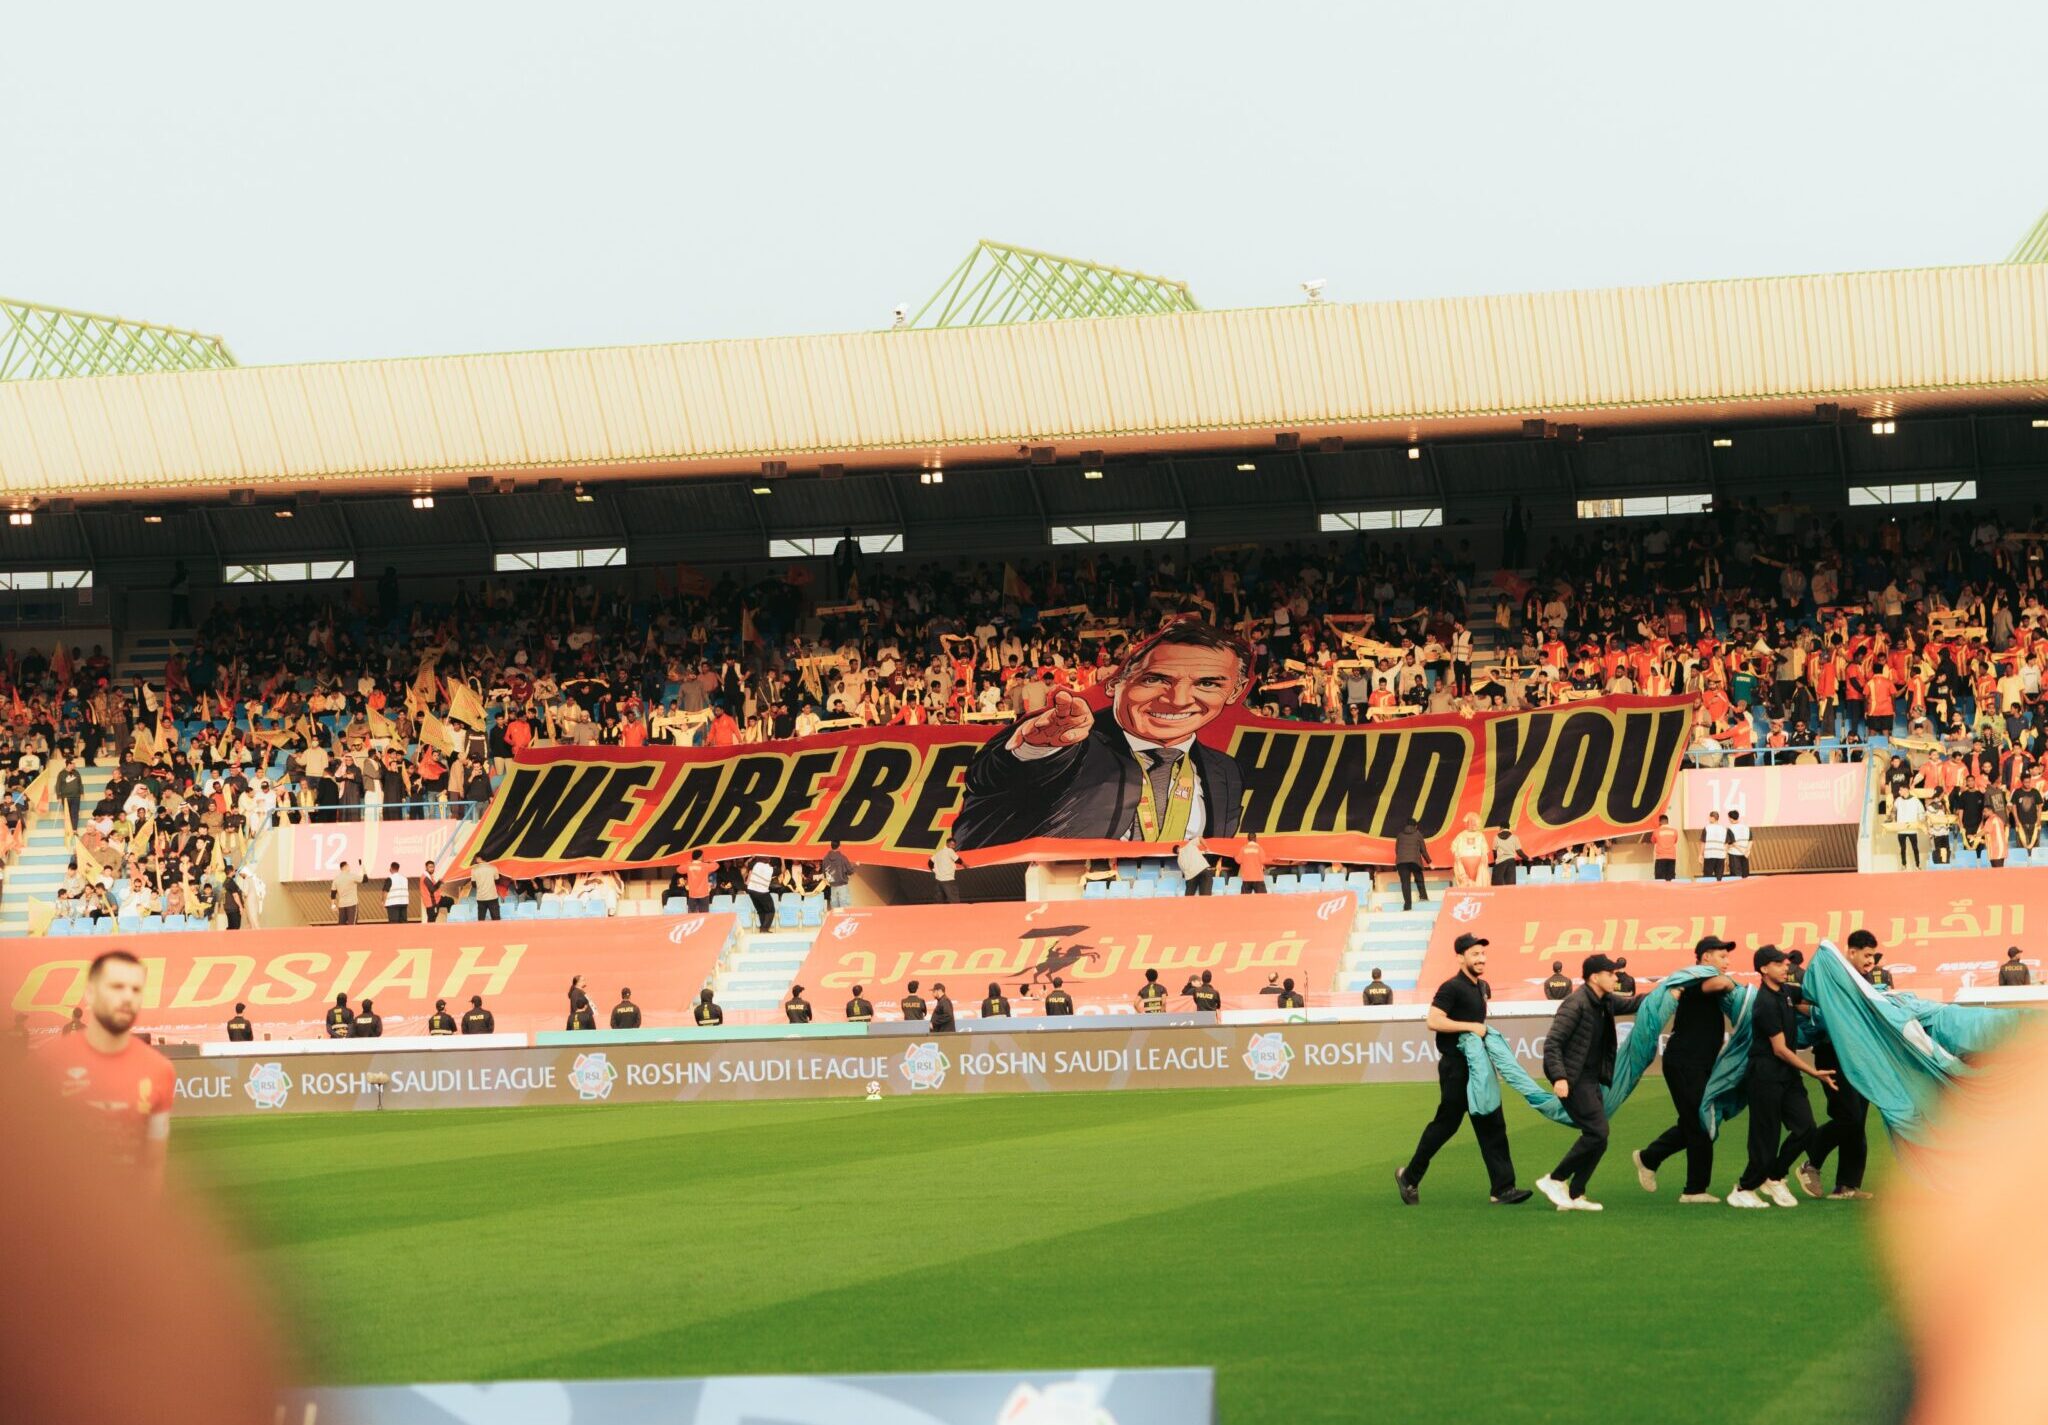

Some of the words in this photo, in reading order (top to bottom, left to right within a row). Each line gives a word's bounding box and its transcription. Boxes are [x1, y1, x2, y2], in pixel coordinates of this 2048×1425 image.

[470, 763, 656, 866] WE
[625, 749, 839, 862] ARE
[1484, 706, 1690, 828] YOU
[1705, 777, 1747, 816] 14
[310, 832, 348, 871] 12
[819, 936, 1062, 988] المدرج
[1070, 930, 1311, 979] فرسان
[1369, 987, 1387, 995] POLICE
[617, 1006, 634, 1014] POLICE
[916, 1061, 934, 1071] RSL
[959, 1051, 1047, 1076] ROSHN
[1053, 1048, 1129, 1074] SAUDI
[1135, 1046, 1230, 1071] LEAGUE
[1260, 1052, 1277, 1061] RSL
[1304, 1041, 1394, 1066] ROSHN
[390, 1069, 462, 1093] SAUDI
[467, 1066, 557, 1091] LEAGUE
[626, 1061, 712, 1086] ROSHN
[718, 1058, 792, 1083] SAUDI
[797, 1056, 889, 1081] LEAGUE
[173, 1075, 232, 1099] AGUE
